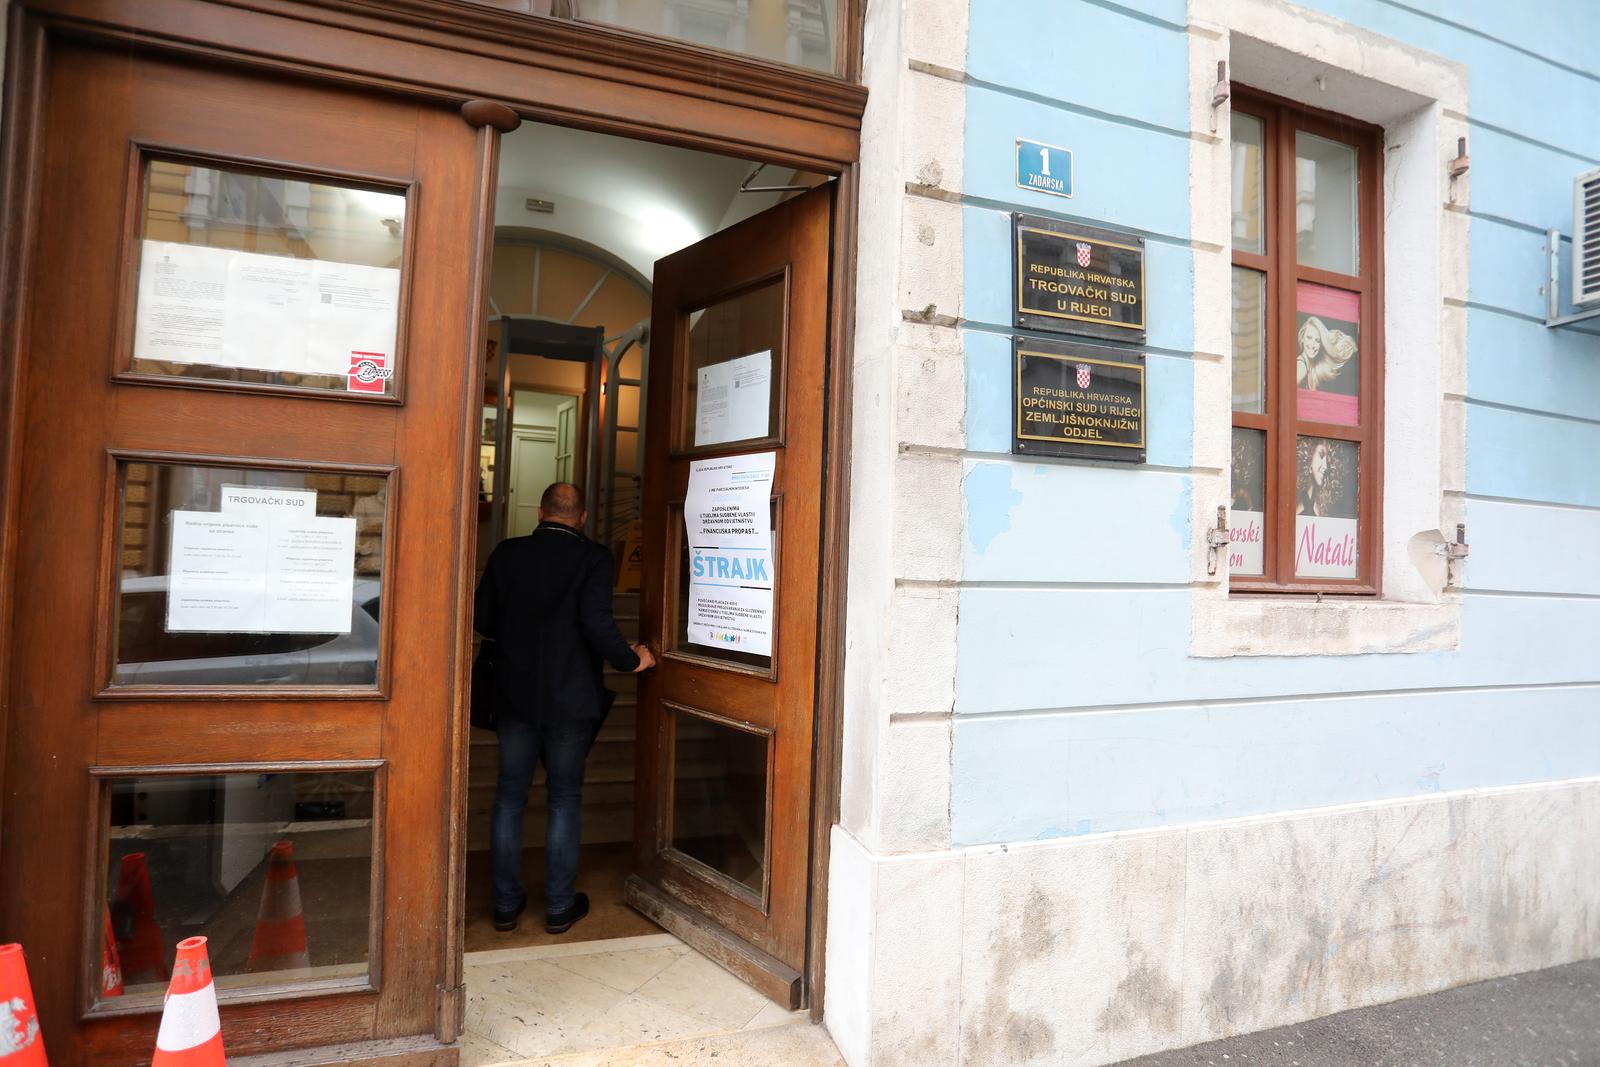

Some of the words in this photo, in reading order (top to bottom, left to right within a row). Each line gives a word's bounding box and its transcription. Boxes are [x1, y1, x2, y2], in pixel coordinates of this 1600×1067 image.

[1039, 148, 1051, 176] 1
[1028, 173, 1064, 191] ZADARSKA
[1030, 263, 1085, 281] REPUBLIKA
[1087, 272, 1135, 288] HRVATSKA
[1029, 278, 1107, 301] TRGOVAČKI
[1110, 291, 1137, 305] SUD
[1057, 299, 1067, 311] U
[1070, 301, 1112, 317] RIJECI
[1033, 386, 1085, 399] REPUBLIKA
[1087, 393, 1132, 405] HRVATSKA
[1023, 396, 1073, 411] OPĆINSKI
[1076, 402, 1097, 414] SUD
[1100, 406, 1107, 414] U
[1109, 406, 1141, 418] RIJECI
[1025, 411, 1138, 430] ZEMLJIŠNOKNJIŽNI
[1063, 427, 1103, 439] ODJEL
[228, 495, 283, 505] TRGOVAČKI
[285, 498, 305, 507] SUD
[1296, 522, 1354, 572] Natali
[693, 550, 768, 581] ŠTRAJK
